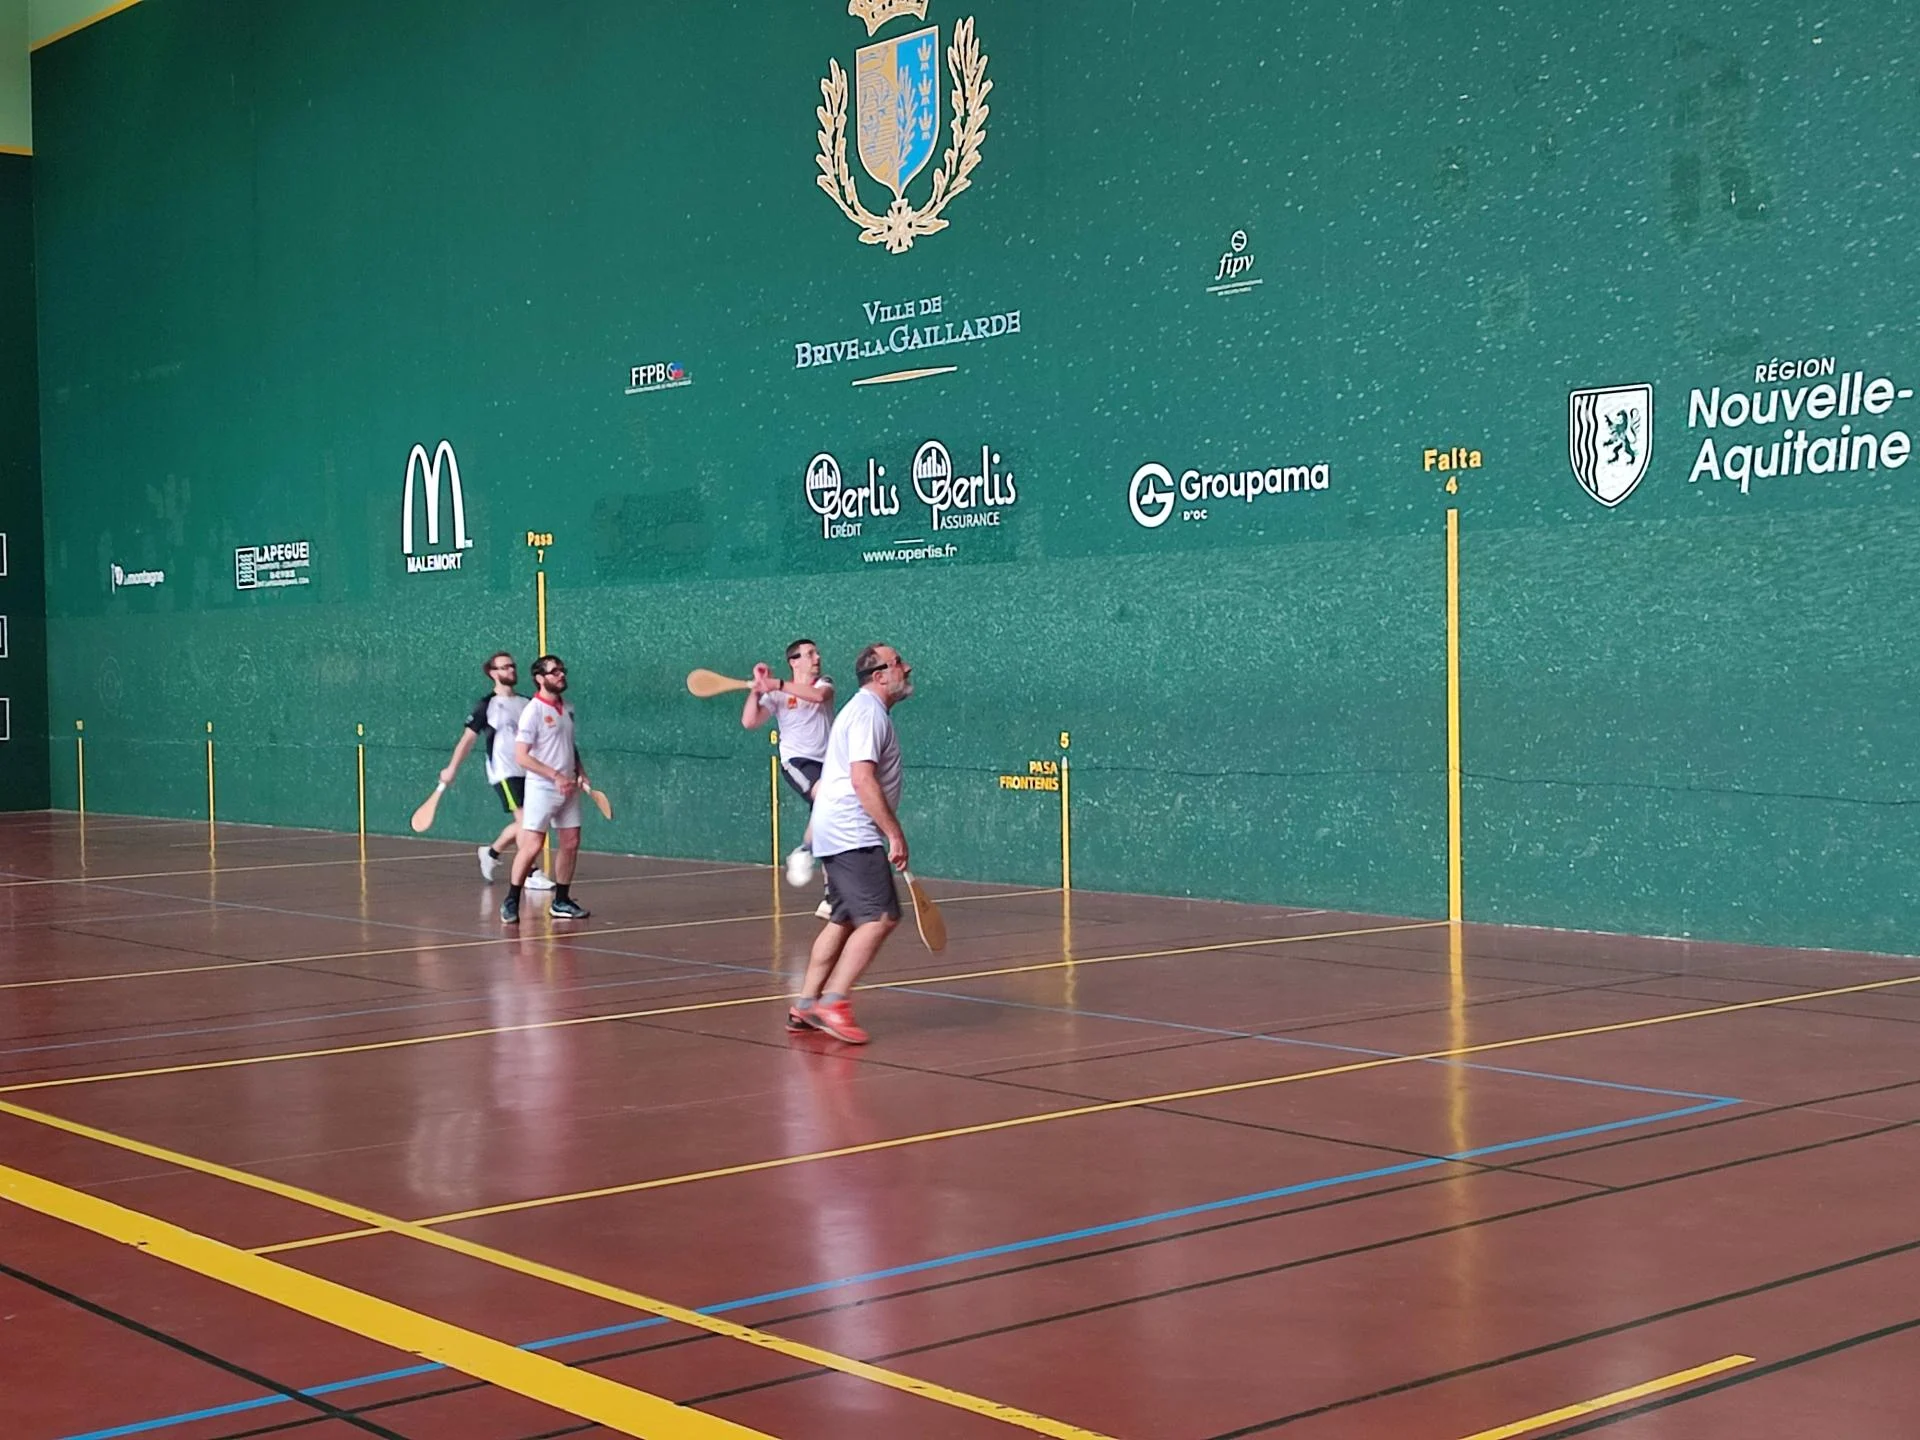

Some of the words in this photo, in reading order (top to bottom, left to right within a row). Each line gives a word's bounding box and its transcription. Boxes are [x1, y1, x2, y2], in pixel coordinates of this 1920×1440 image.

[1215, 252, 1254, 281] fipv
[1754, 356, 1836, 383] RÉGION
[1687, 371, 1914, 429] Nouvelle-
[1423, 447, 1482, 472] Falta
[1688, 424, 1911, 494] Aquitaine
[1180, 463, 1329, 503] Groupama
[1445, 476, 1458, 495] 4
[940, 511, 1000, 530] ASSURANCE
[527, 531, 553, 547] Pasa
[830, 522, 863, 539] CRÉDIT
[256, 541, 309, 562] LAPEGUE
[537, 549, 545, 563] 7
[862, 543, 957, 564] www.operlis.fr
[407, 553, 463, 573] MALEMORT
[770, 730, 778, 745] 6
[1060, 732, 1070, 749] 5
[1029, 761, 1059, 775] PASA
[999, 776, 1060, 791] FRONTENIS
